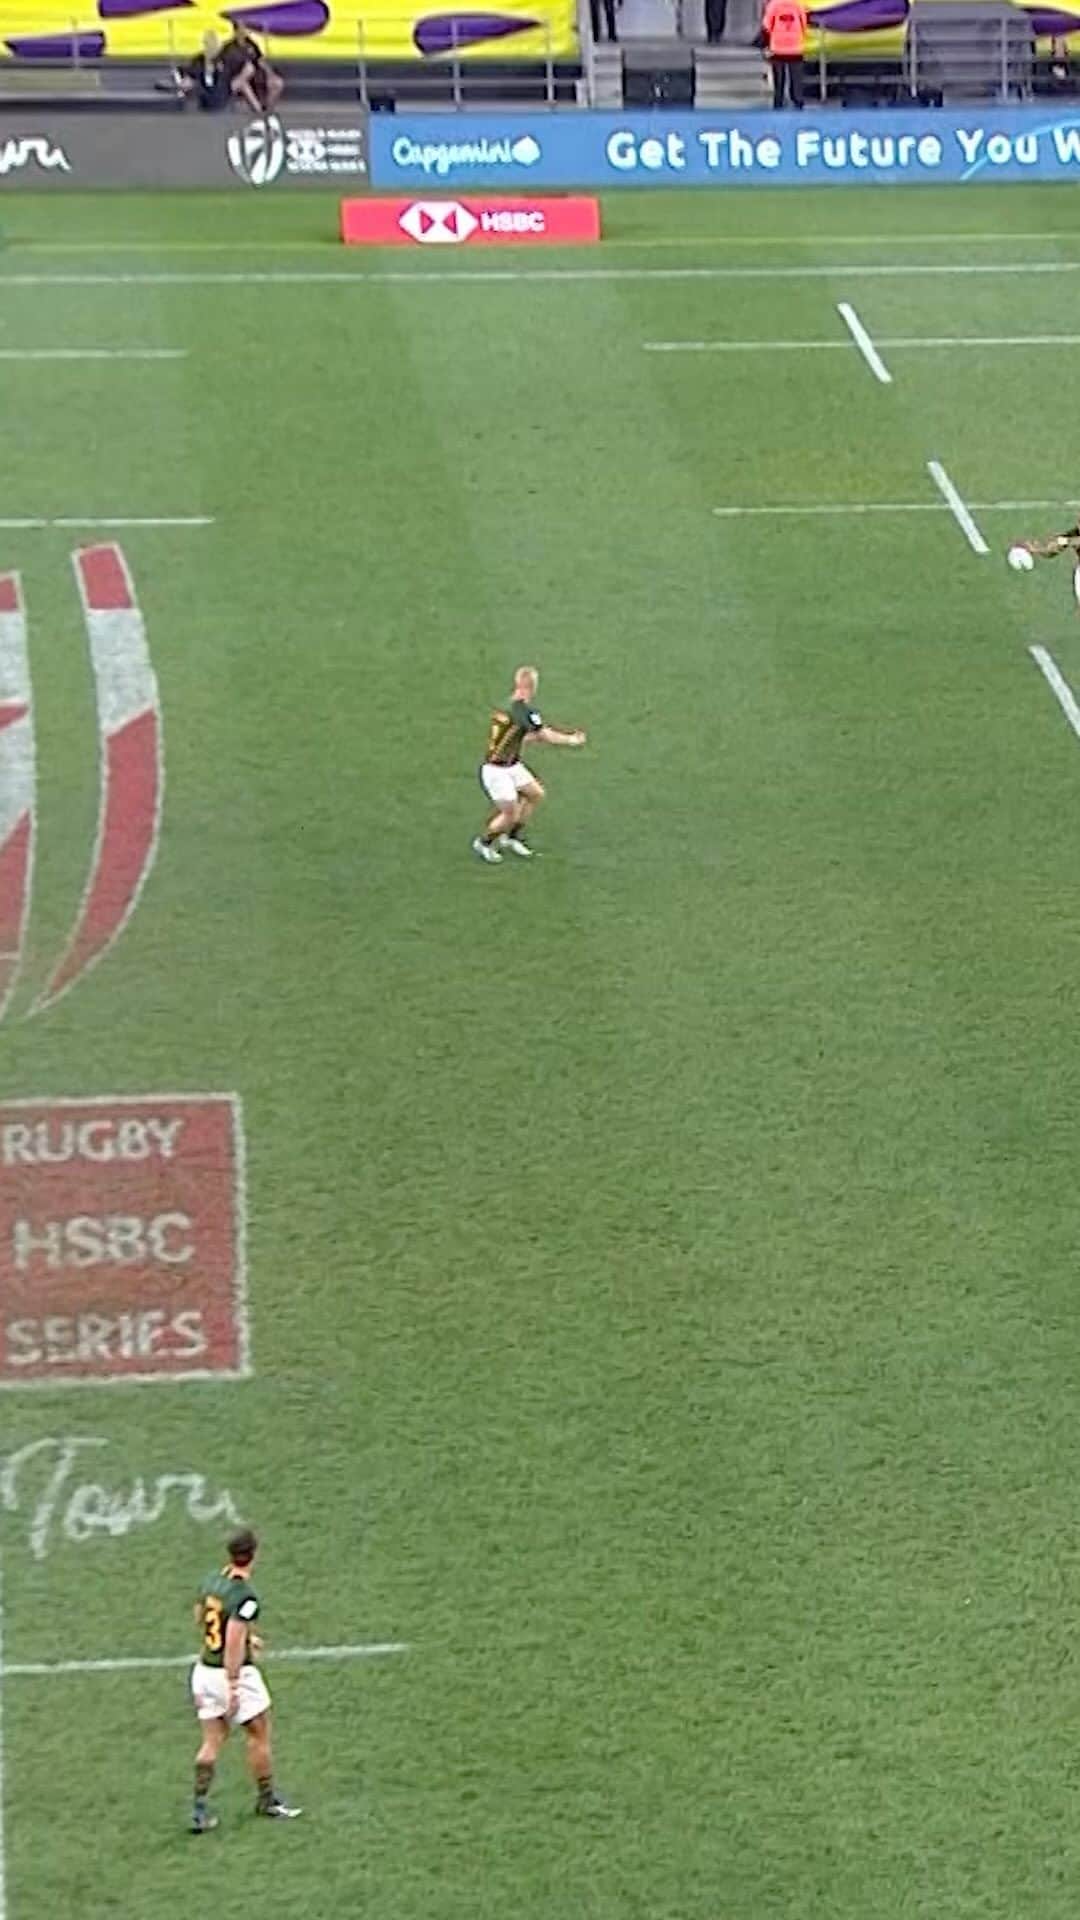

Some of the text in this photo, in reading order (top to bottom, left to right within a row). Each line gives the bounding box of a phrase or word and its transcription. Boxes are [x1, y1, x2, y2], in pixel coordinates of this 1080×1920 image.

[392, 136, 513, 176] Capgemini
[606, 130, 686, 169] Get
[700, 128, 781, 168] The
[796, 129, 942, 168] Future
[955, 128, 1038, 164] You
[480, 211, 545, 232] HSBC
[2, 1118, 183, 1164] RUGBY
[13, 1212, 195, 1269] HSBC
[5, 1310, 208, 1365] SERIES
[203, 1594, 223, 1651] 3
